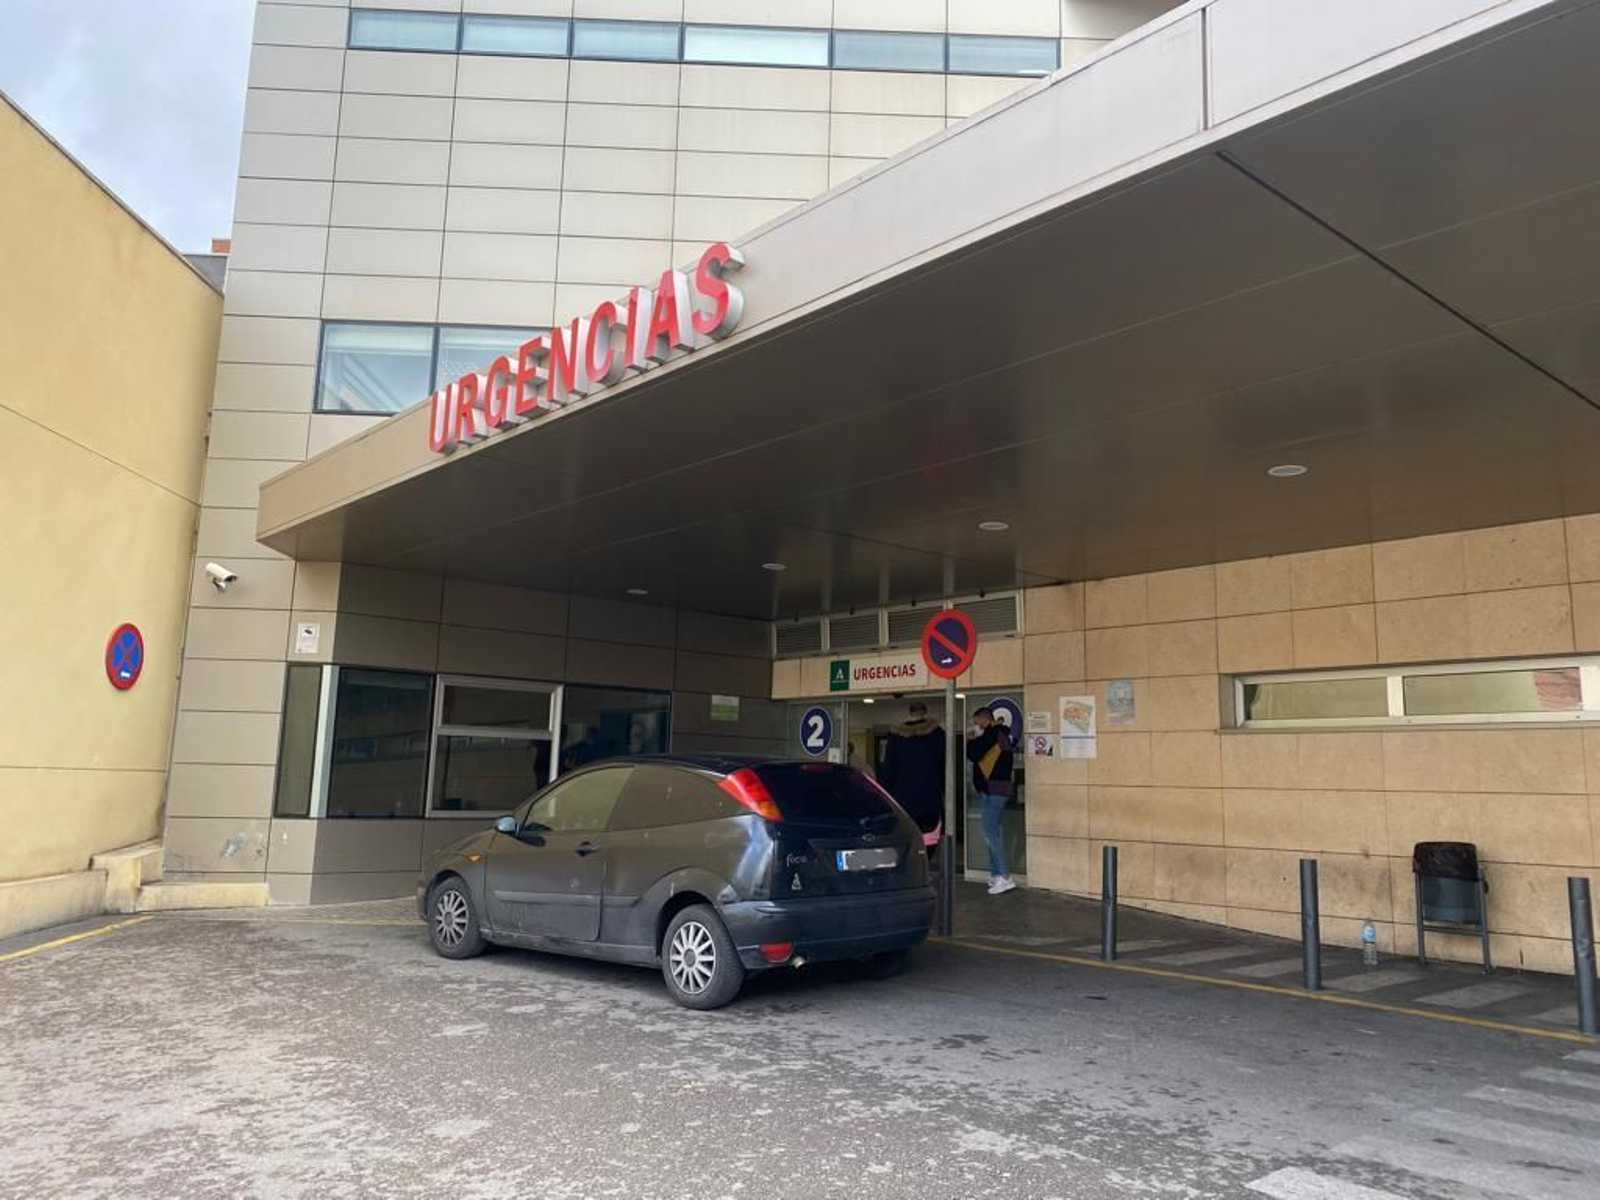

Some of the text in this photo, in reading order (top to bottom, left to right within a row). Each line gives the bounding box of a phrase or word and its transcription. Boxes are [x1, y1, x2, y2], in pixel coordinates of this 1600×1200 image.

[429, 241, 743, 453] URGENCIAS
[854, 663, 916, 682] URGENCIAS
[807, 715, 824, 747] 2
